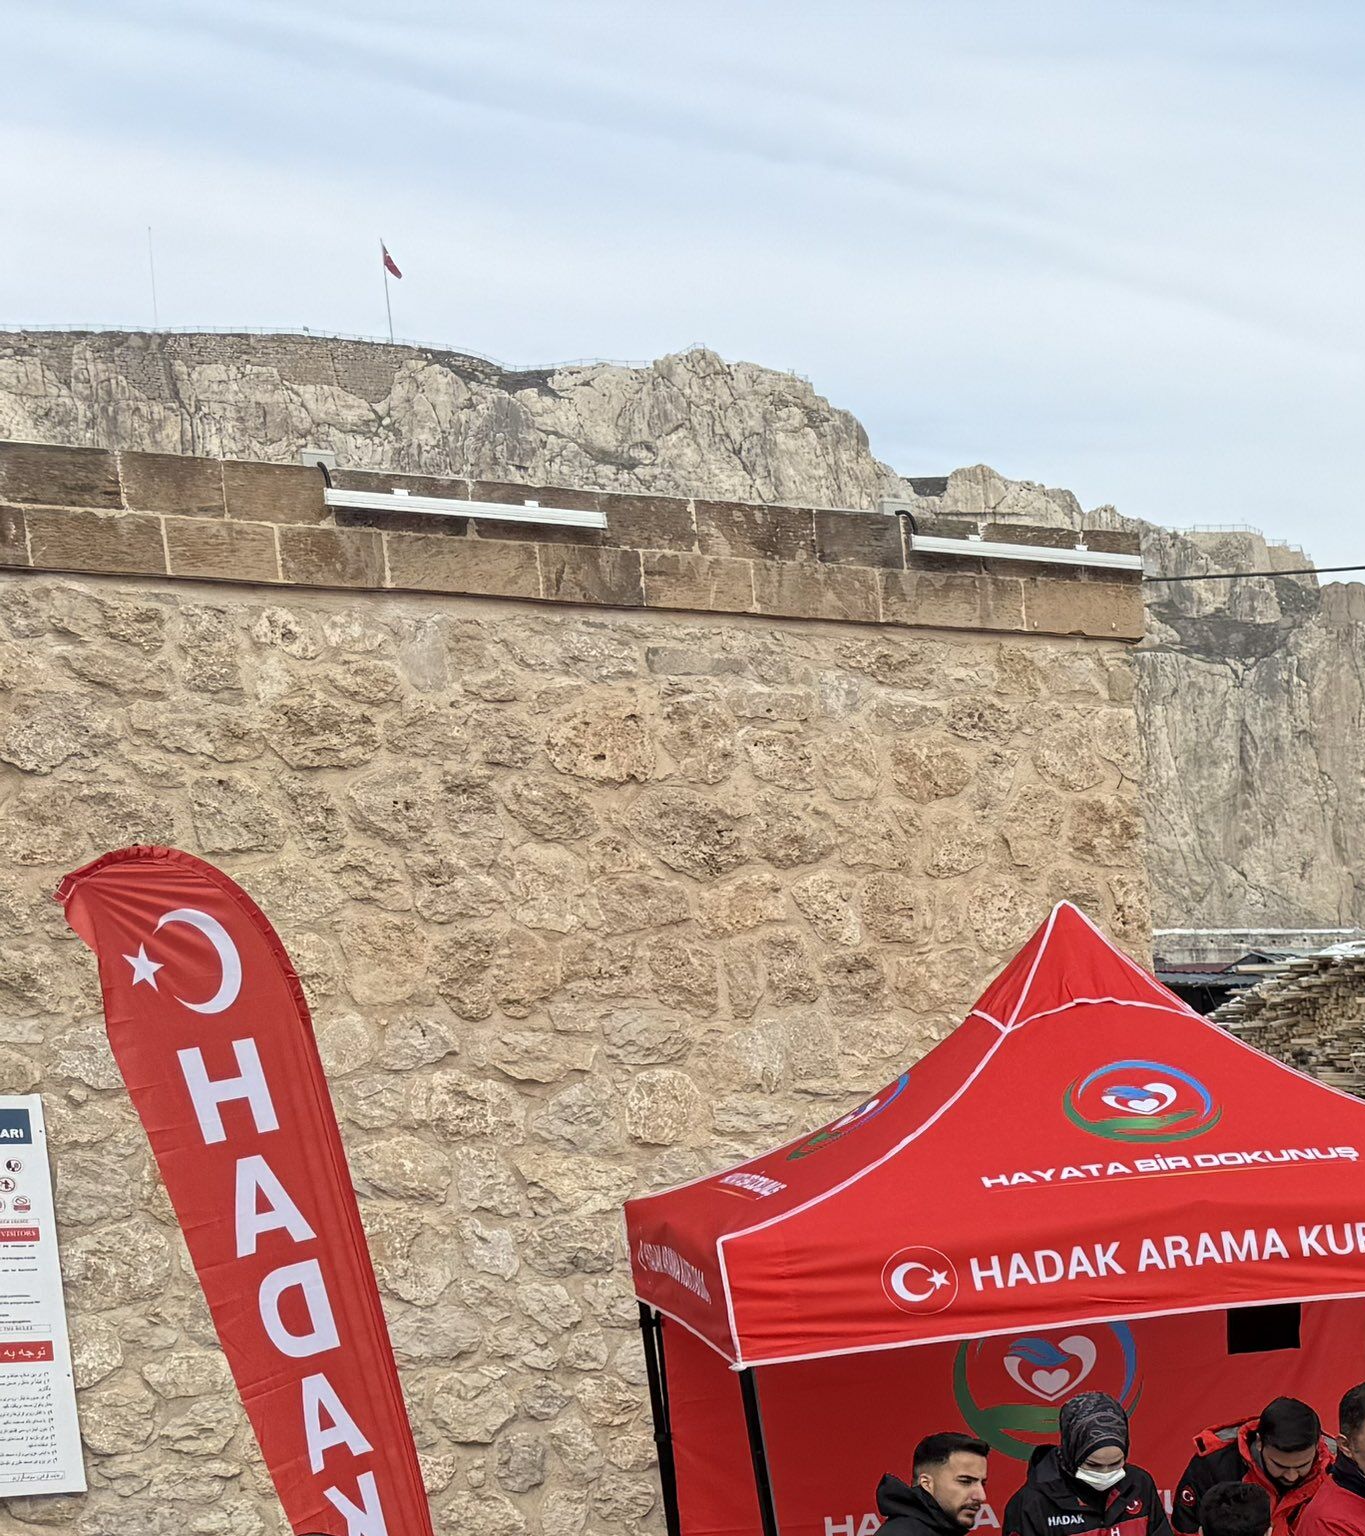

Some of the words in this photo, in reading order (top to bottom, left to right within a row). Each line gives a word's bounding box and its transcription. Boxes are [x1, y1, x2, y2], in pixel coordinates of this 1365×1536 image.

[980, 1163, 1132, 1189] HAYATA
[1134, 1153, 1191, 1175] BİR
[1193, 1146, 1360, 1168] DOKUNUŞ
[969, 1241, 1126, 1292] HADAK
[1137, 1228, 1290, 1273] ARAMA
[1047, 1513, 1085, 1527] HADAK
